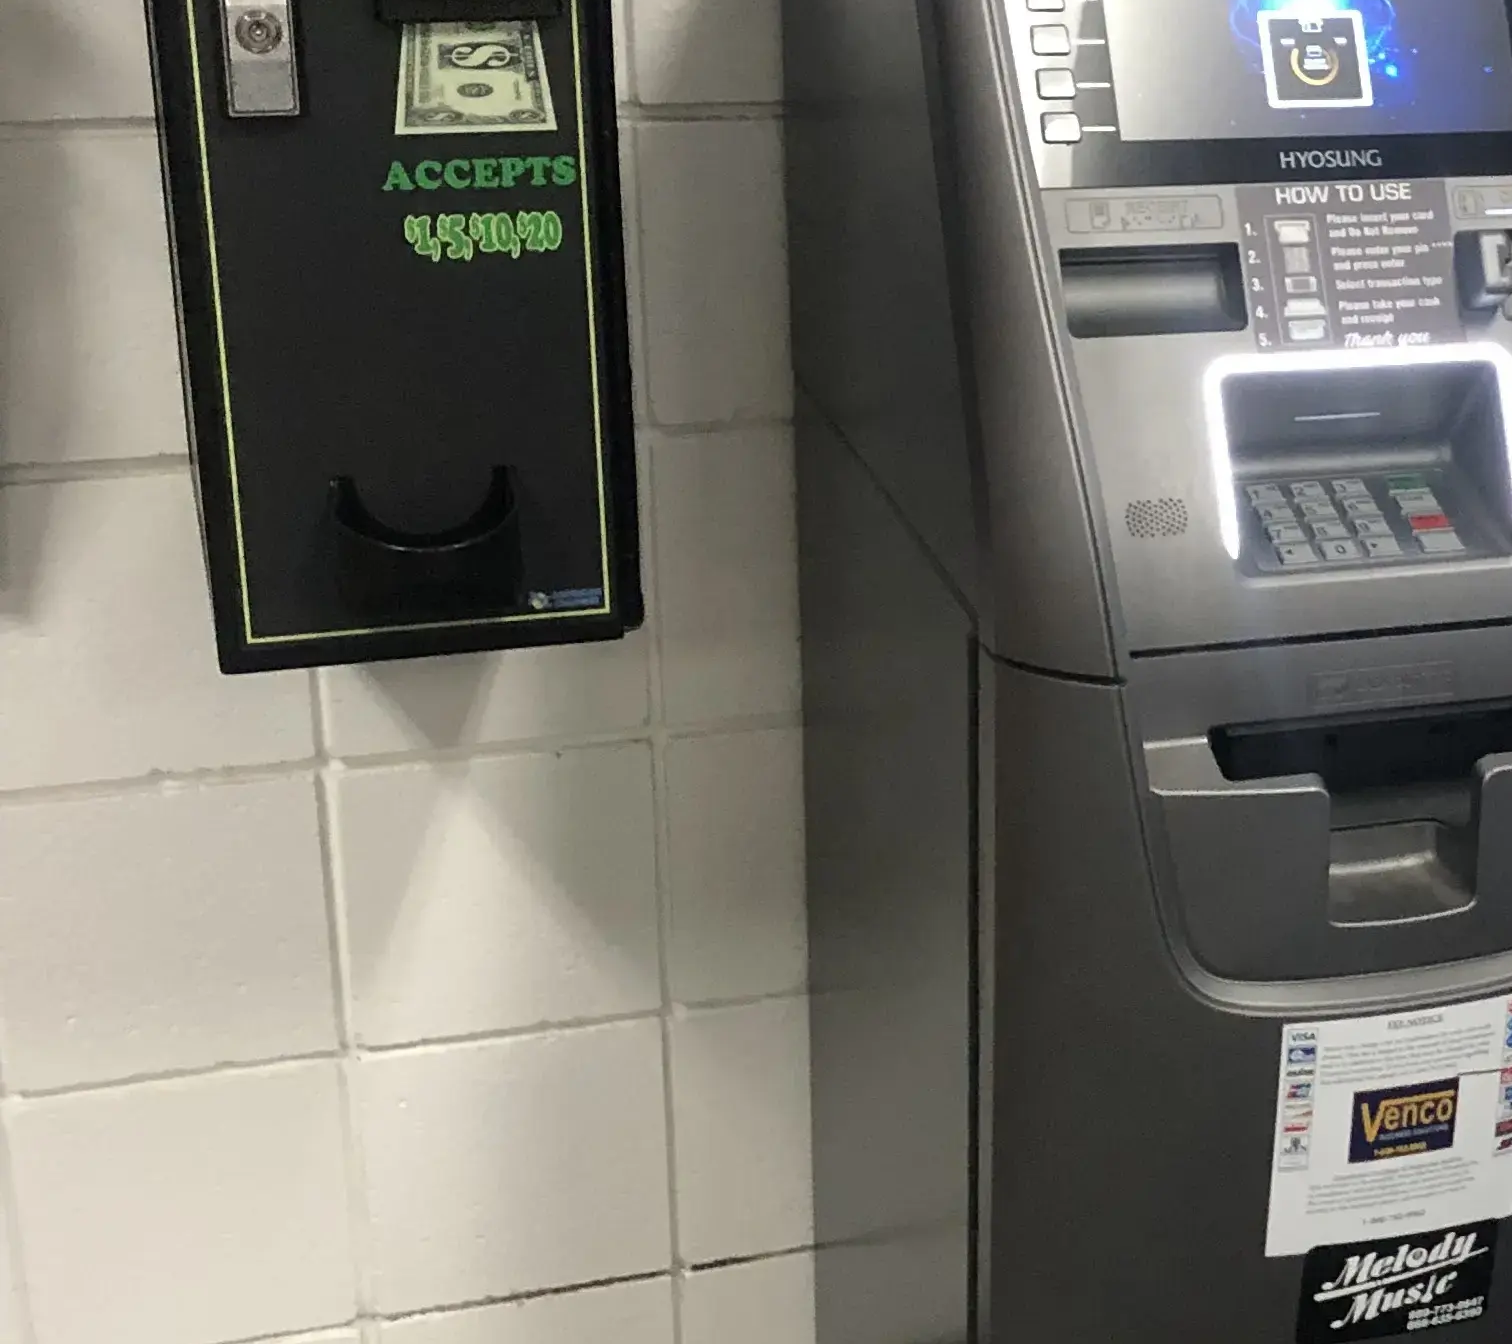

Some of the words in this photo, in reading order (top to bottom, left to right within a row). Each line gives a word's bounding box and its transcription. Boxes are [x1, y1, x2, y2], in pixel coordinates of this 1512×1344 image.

[1279, 149, 1382, 169] HYOSUNG
[381, 155, 577, 191] ACCEPTS
[1274, 186, 1329, 205] HOW
[1335, 185, 1364, 203] TO
[1370, 182, 1412, 201] USE
[1326, 212, 1358, 224] Please
[1412, 210, 1434, 221] card
[1330, 245, 1363, 258] Please
[1344, 331, 1393, 348] Thank
[1396, 332, 1431, 348] you
[1291, 1032, 1316, 1042] VISA
[1361, 1089, 1455, 1143] Venco
[1321, 1232, 1484, 1291] Melody
[1329, 1271, 1458, 1331] Music
